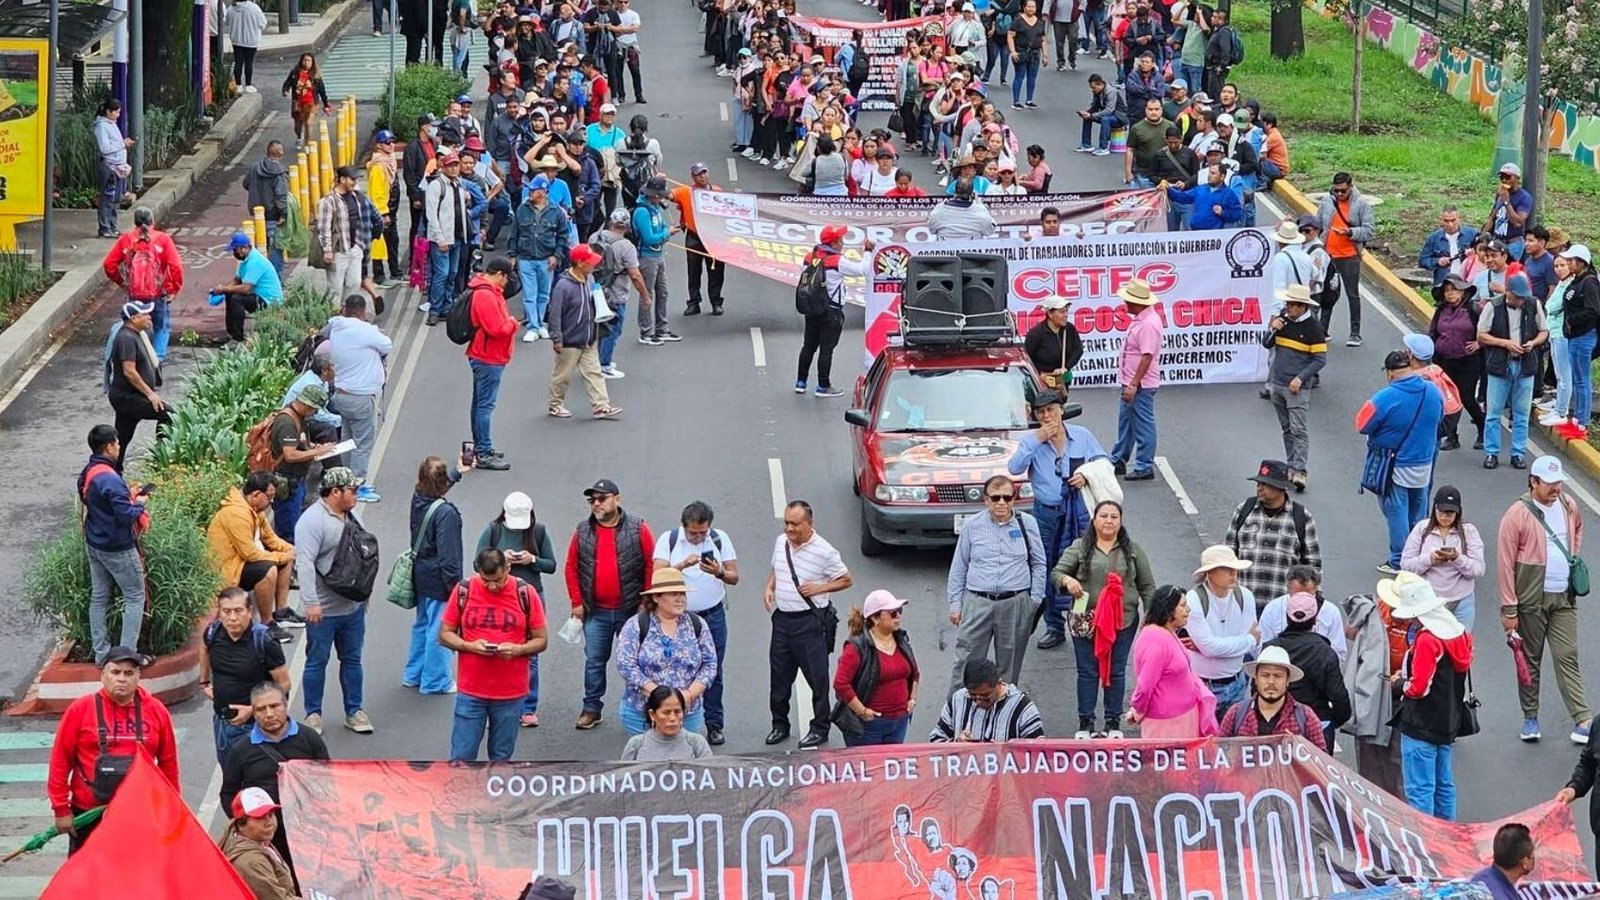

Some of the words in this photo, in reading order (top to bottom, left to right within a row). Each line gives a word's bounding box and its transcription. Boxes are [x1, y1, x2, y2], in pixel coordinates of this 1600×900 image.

[867, 37, 908, 47] VILLARR
[874, 102, 896, 110] AFOR
[0, 143, 20, 154] DIAL
[809, 209, 931, 217] COORDINADOR
[1018, 247, 1029, 260] DE
[1030, 244, 1094, 260] TRABAJADORES
[1095, 244, 1105, 258] DE
[1107, 243, 1117, 257] LA
[1119, 241, 1166, 257] EDUCACIÓN
[1167, 241, 1178, 254] EN
[1180, 238, 1222, 254] GUERRERO
[1012, 262, 1179, 303] CETEG
[1172, 297, 1263, 328] CHICA
[1110, 337, 1124, 351] LO
[1191, 332, 1205, 347] SE
[1169, 368, 1203, 381] CHICA
[466, 606, 518, 632] GAP
[486, 767, 716, 797] COORDINADORA
[727, 762, 873, 790] NACIONAL
[884, 758, 919, 781] DE
[929, 749, 1143, 778] TRABAJADORES
[1153, 747, 1187, 772] DE
[1198, 745, 1229, 770] LA
